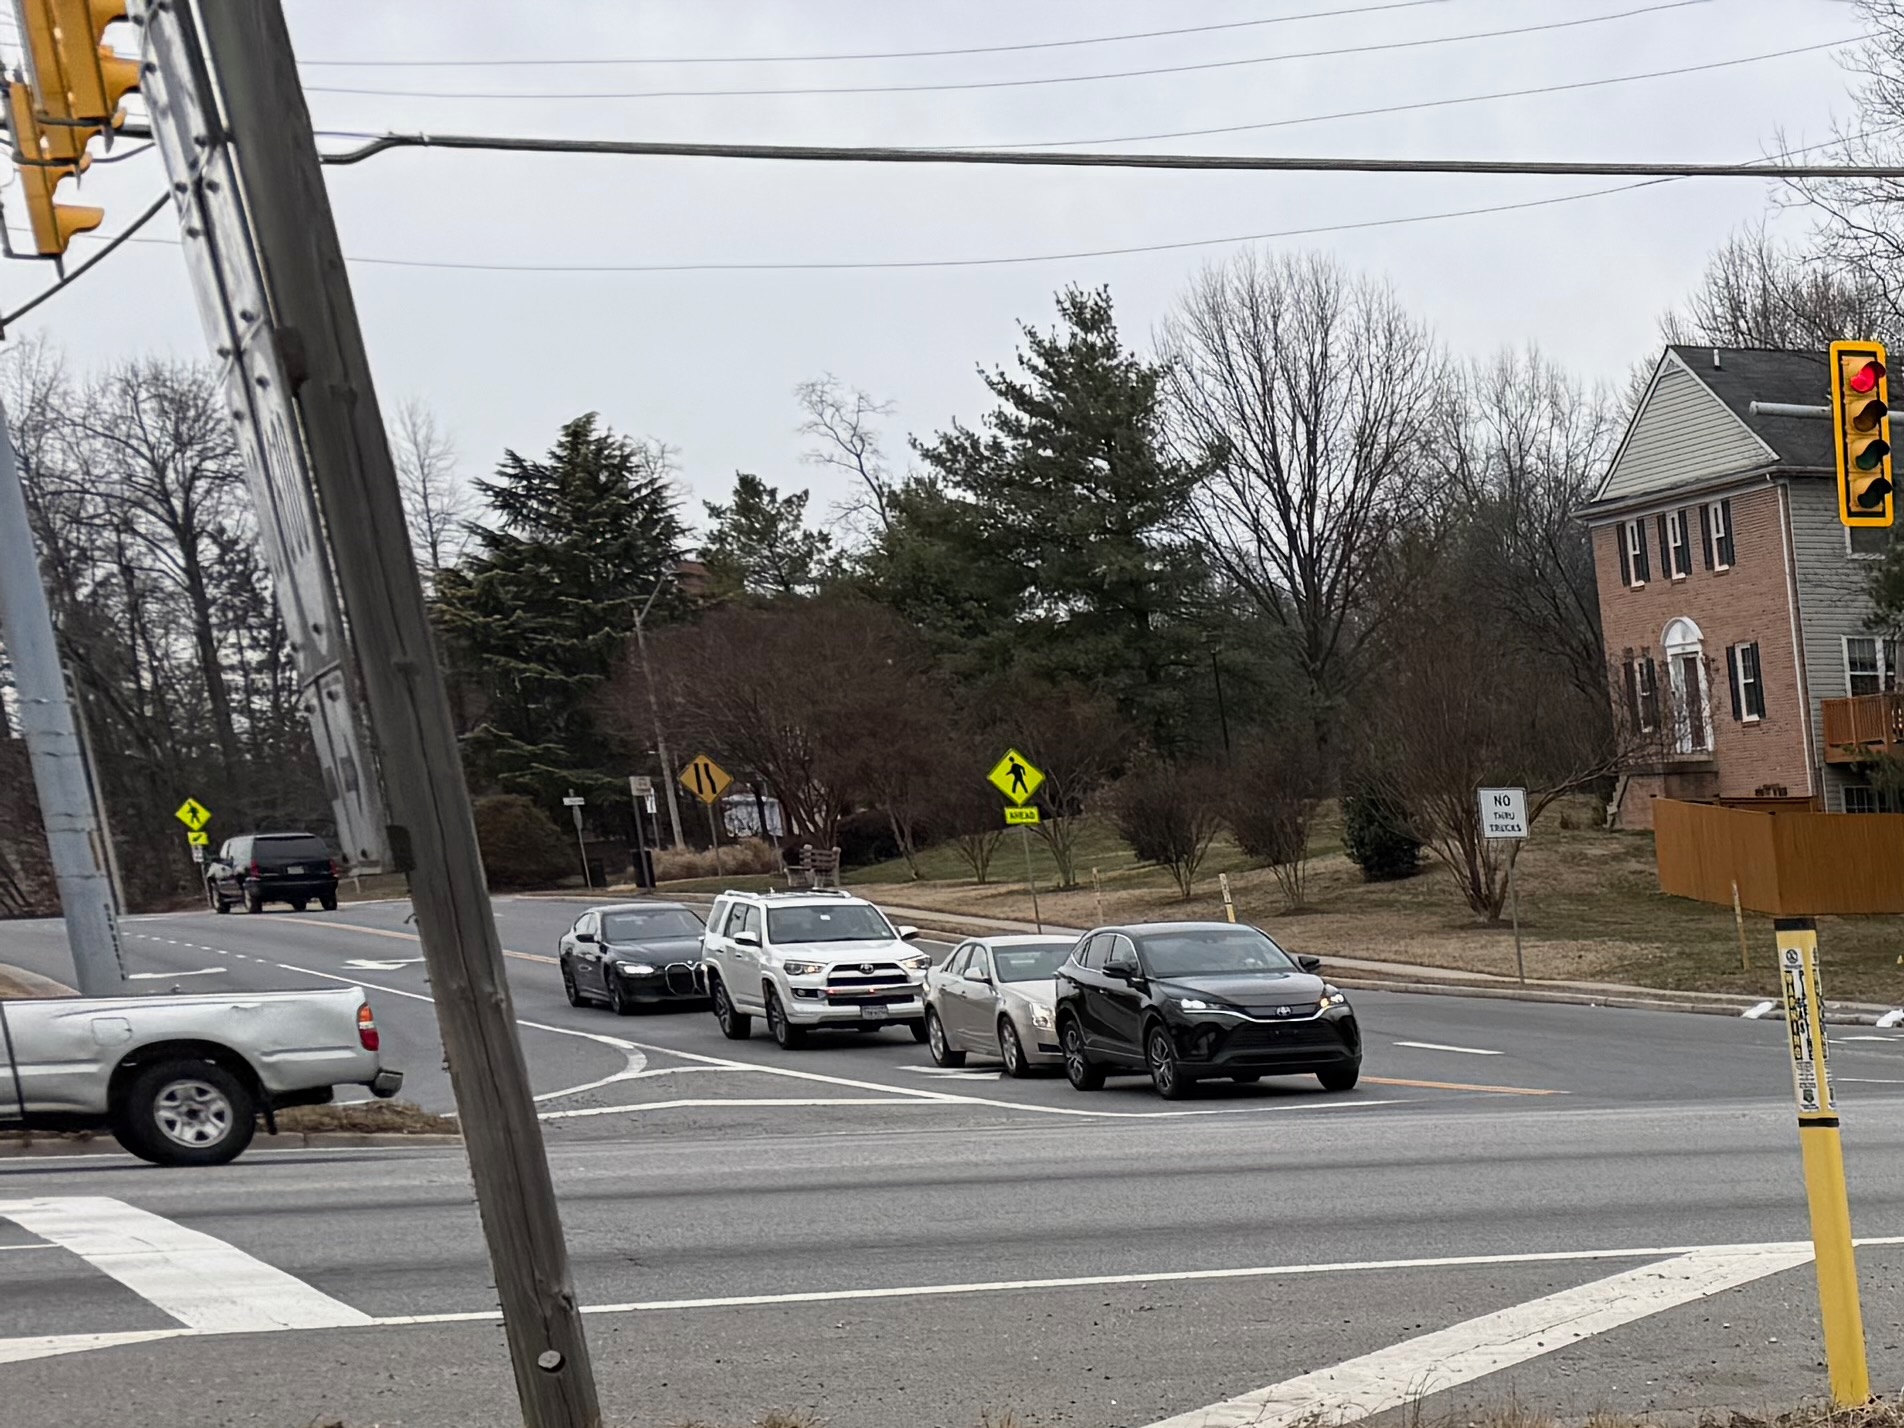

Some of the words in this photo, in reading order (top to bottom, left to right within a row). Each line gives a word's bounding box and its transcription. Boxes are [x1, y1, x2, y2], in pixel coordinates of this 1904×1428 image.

[1494, 795, 1510, 806] NO
[1009, 811, 1036, 820] AHEAD
[1494, 811, 1515, 820] THRU
[1489, 824, 1521, 832] TRUCKS
